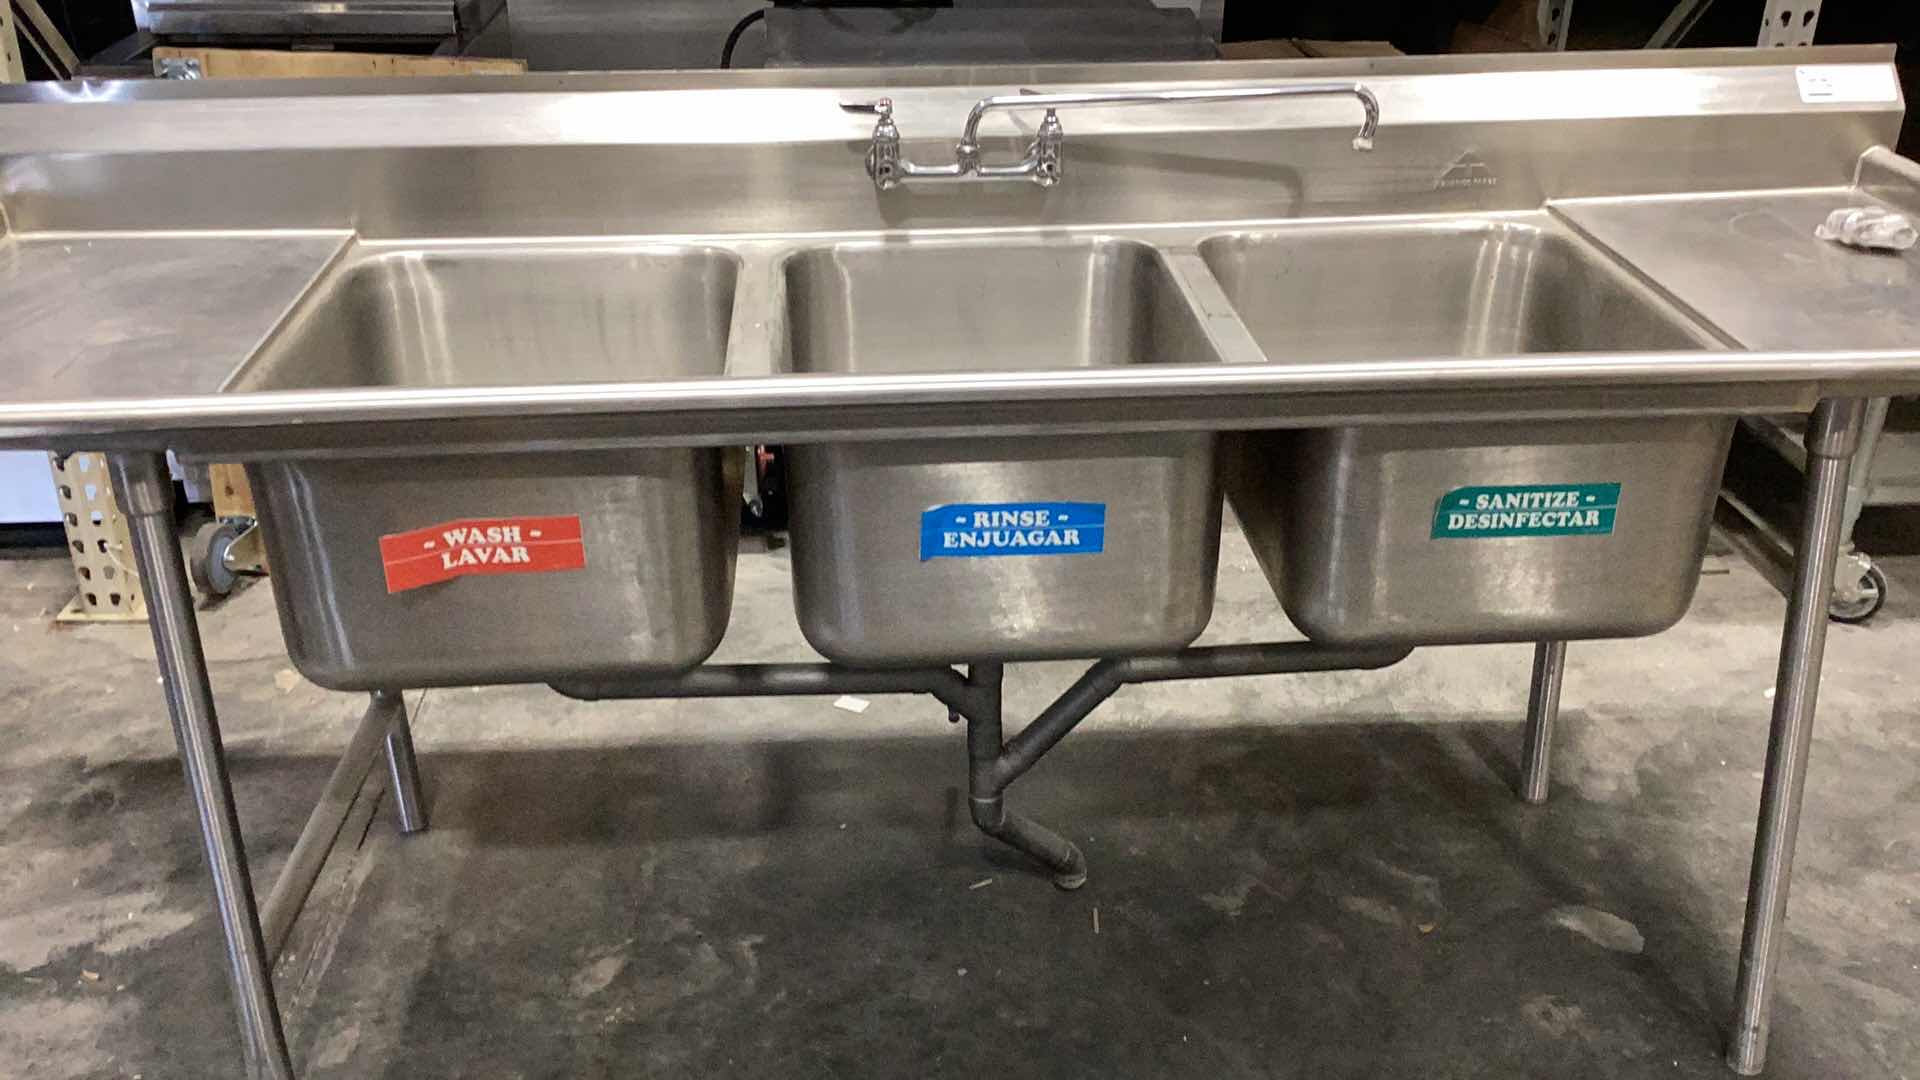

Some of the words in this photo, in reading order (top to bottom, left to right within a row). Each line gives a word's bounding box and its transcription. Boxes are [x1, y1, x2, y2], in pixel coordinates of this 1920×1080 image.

[1475, 491, 1580, 510] SANITIZE
[973, 510, 1050, 528] RINSE
[1447, 510, 1600, 530] DESINFECTAR
[442, 526, 522, 547] WASH
[943, 529, 1080, 548] ENJUAGAR
[441, 546, 531, 570] LAVAR
